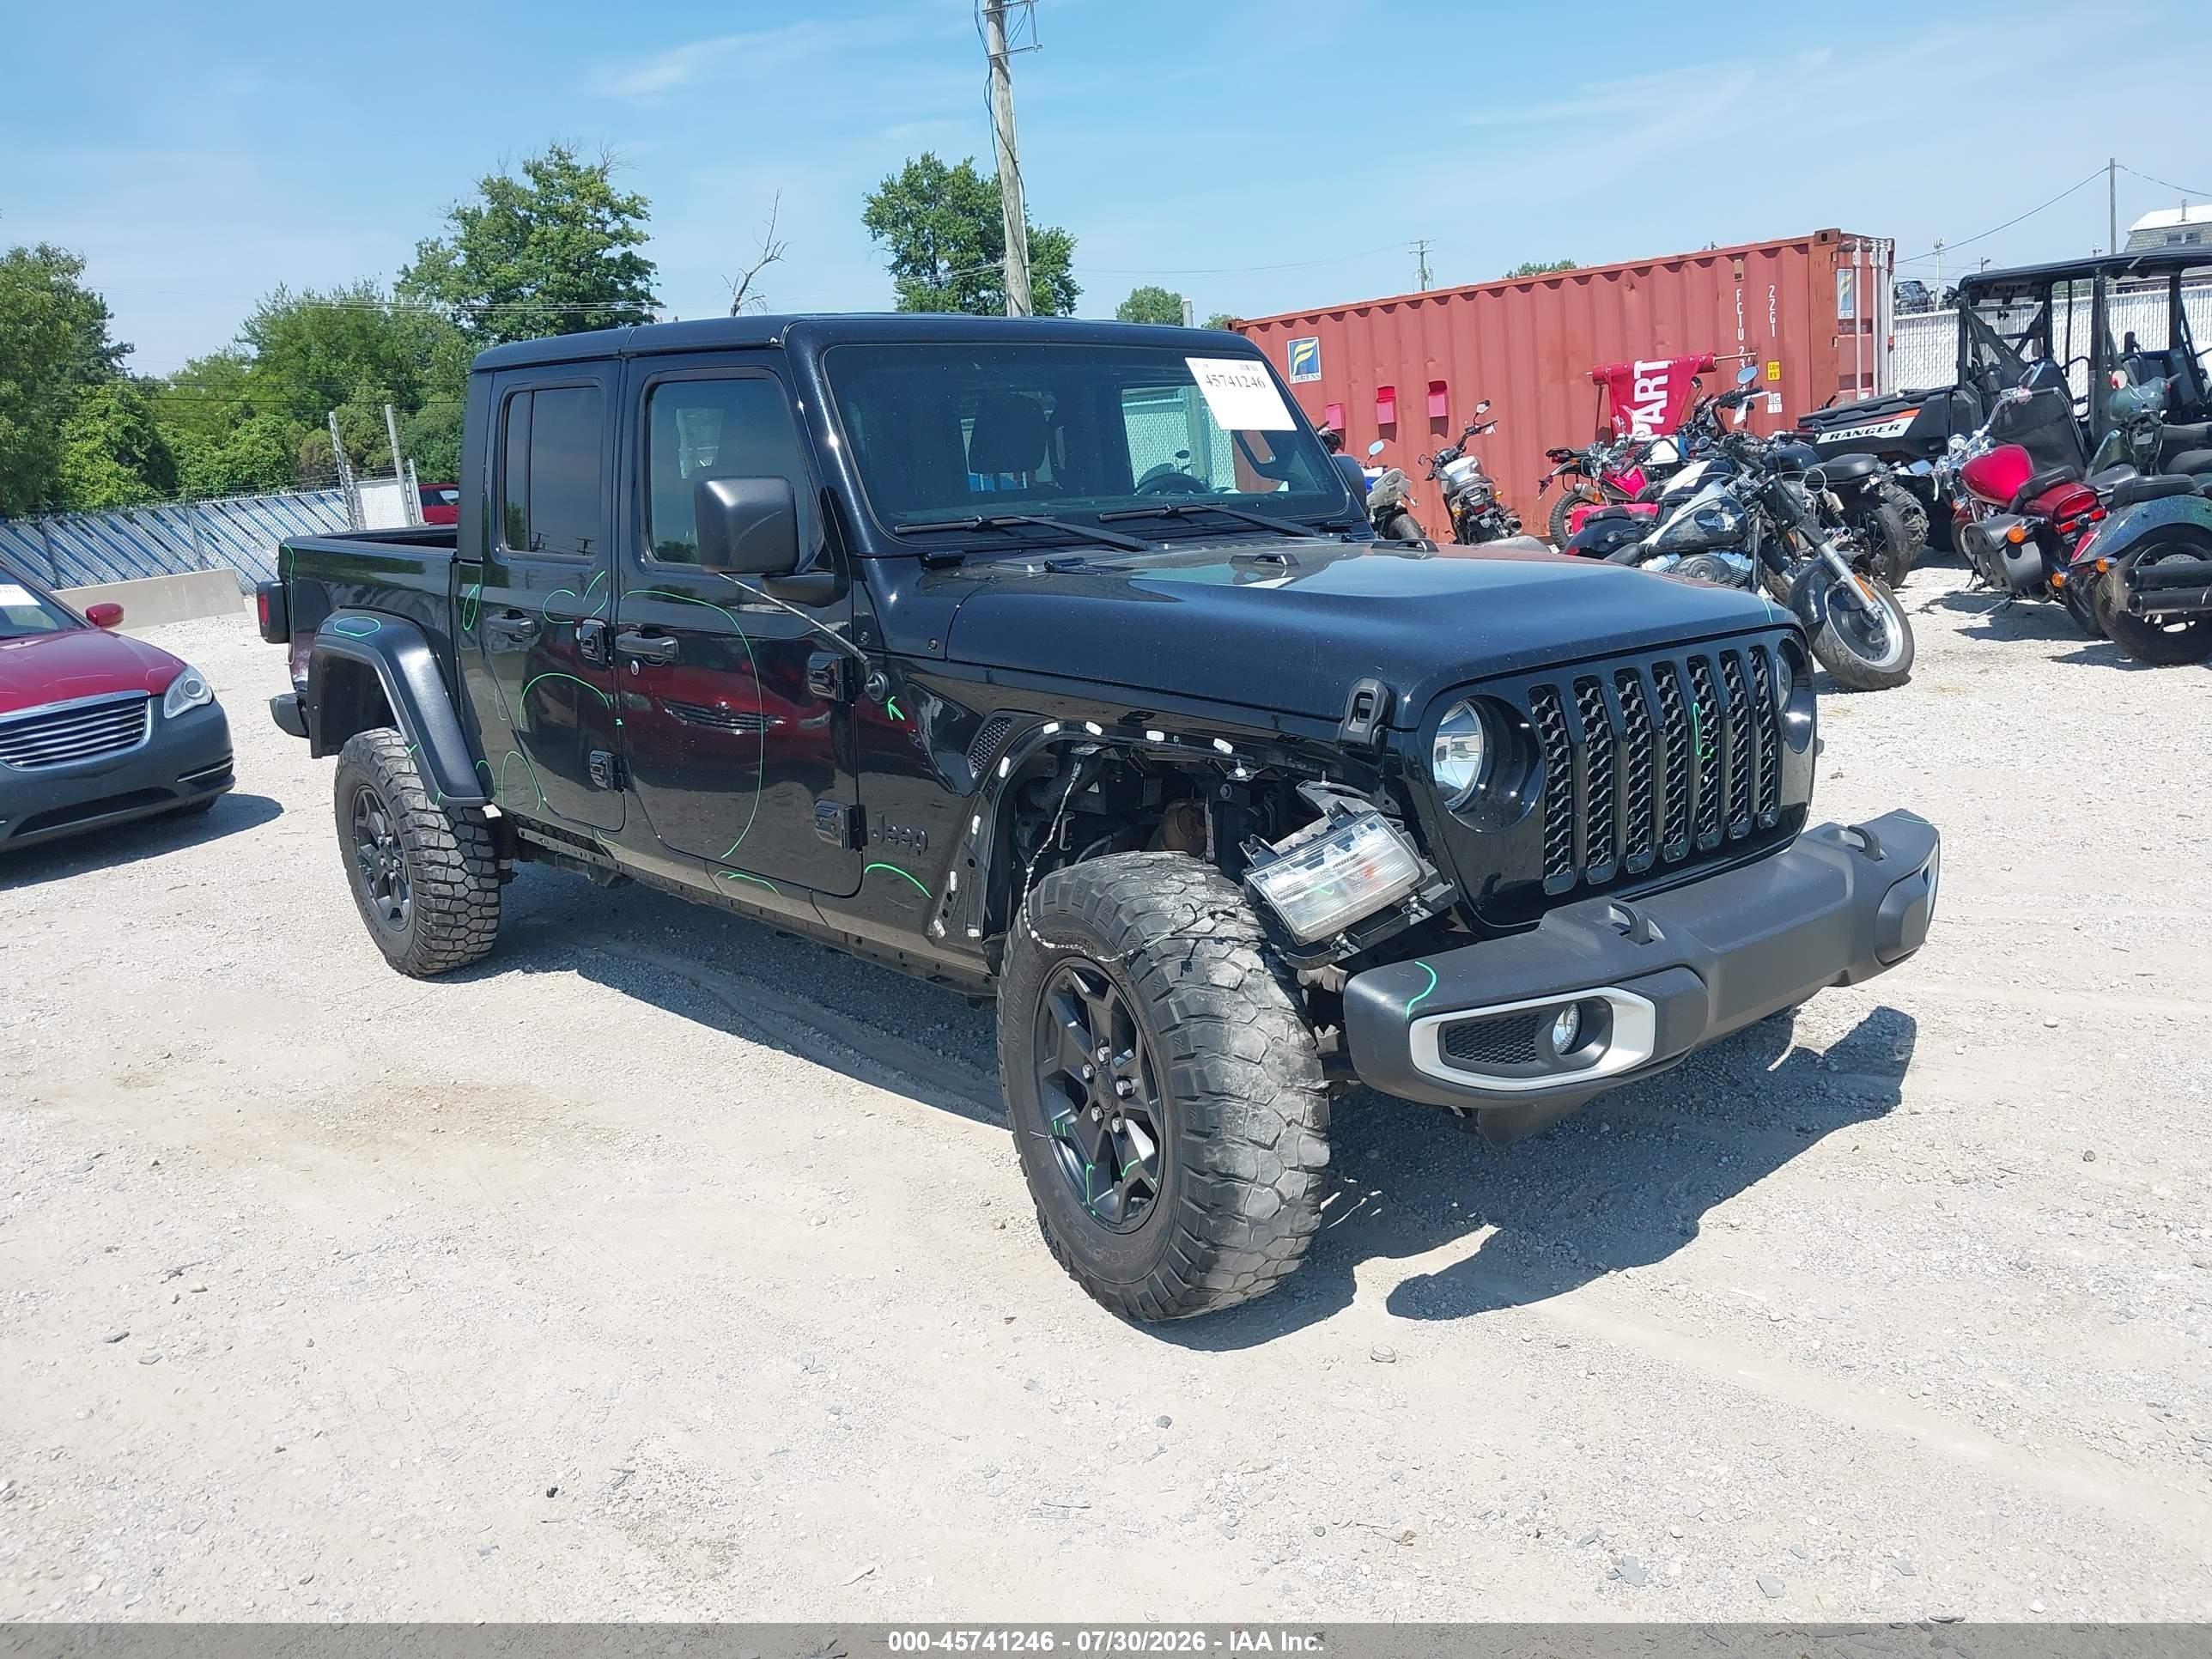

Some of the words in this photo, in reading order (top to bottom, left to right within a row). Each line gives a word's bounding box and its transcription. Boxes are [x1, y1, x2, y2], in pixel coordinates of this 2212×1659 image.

[1735, 289, 1744, 341] FCIU
[1205, 374, 1267, 389] 45741246
[1829, 423, 1901, 441] RANGER
